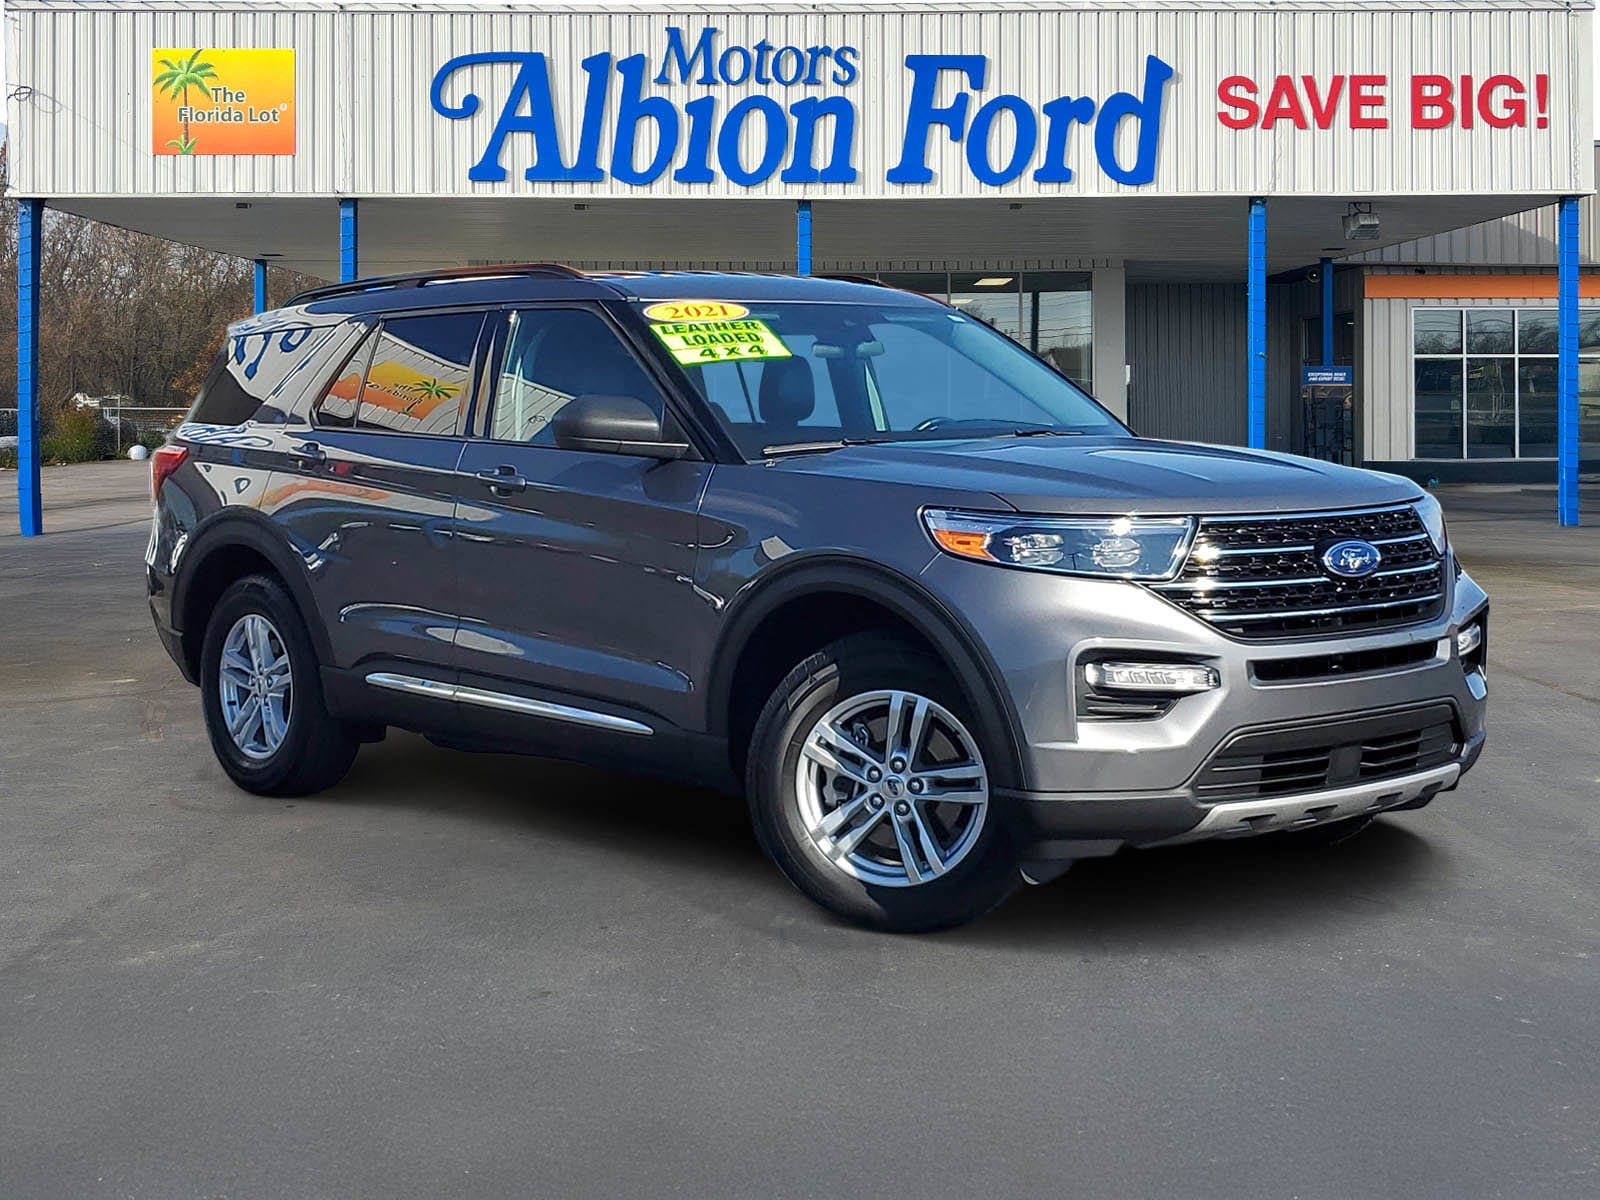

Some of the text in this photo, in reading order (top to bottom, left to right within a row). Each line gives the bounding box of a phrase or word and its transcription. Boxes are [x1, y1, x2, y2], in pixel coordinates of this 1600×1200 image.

[653, 26, 857, 86] Motors
[211, 87, 245, 103] The
[1217, 74, 1548, 129] SAVE BIG!
[178, 107, 279, 122] Florida Lot
[430, 52, 1174, 187] Albion Ford
[664, 304, 729, 319] 2021
[660, 321, 760, 335] LEATHER
[681, 332, 762, 346] LOADED
